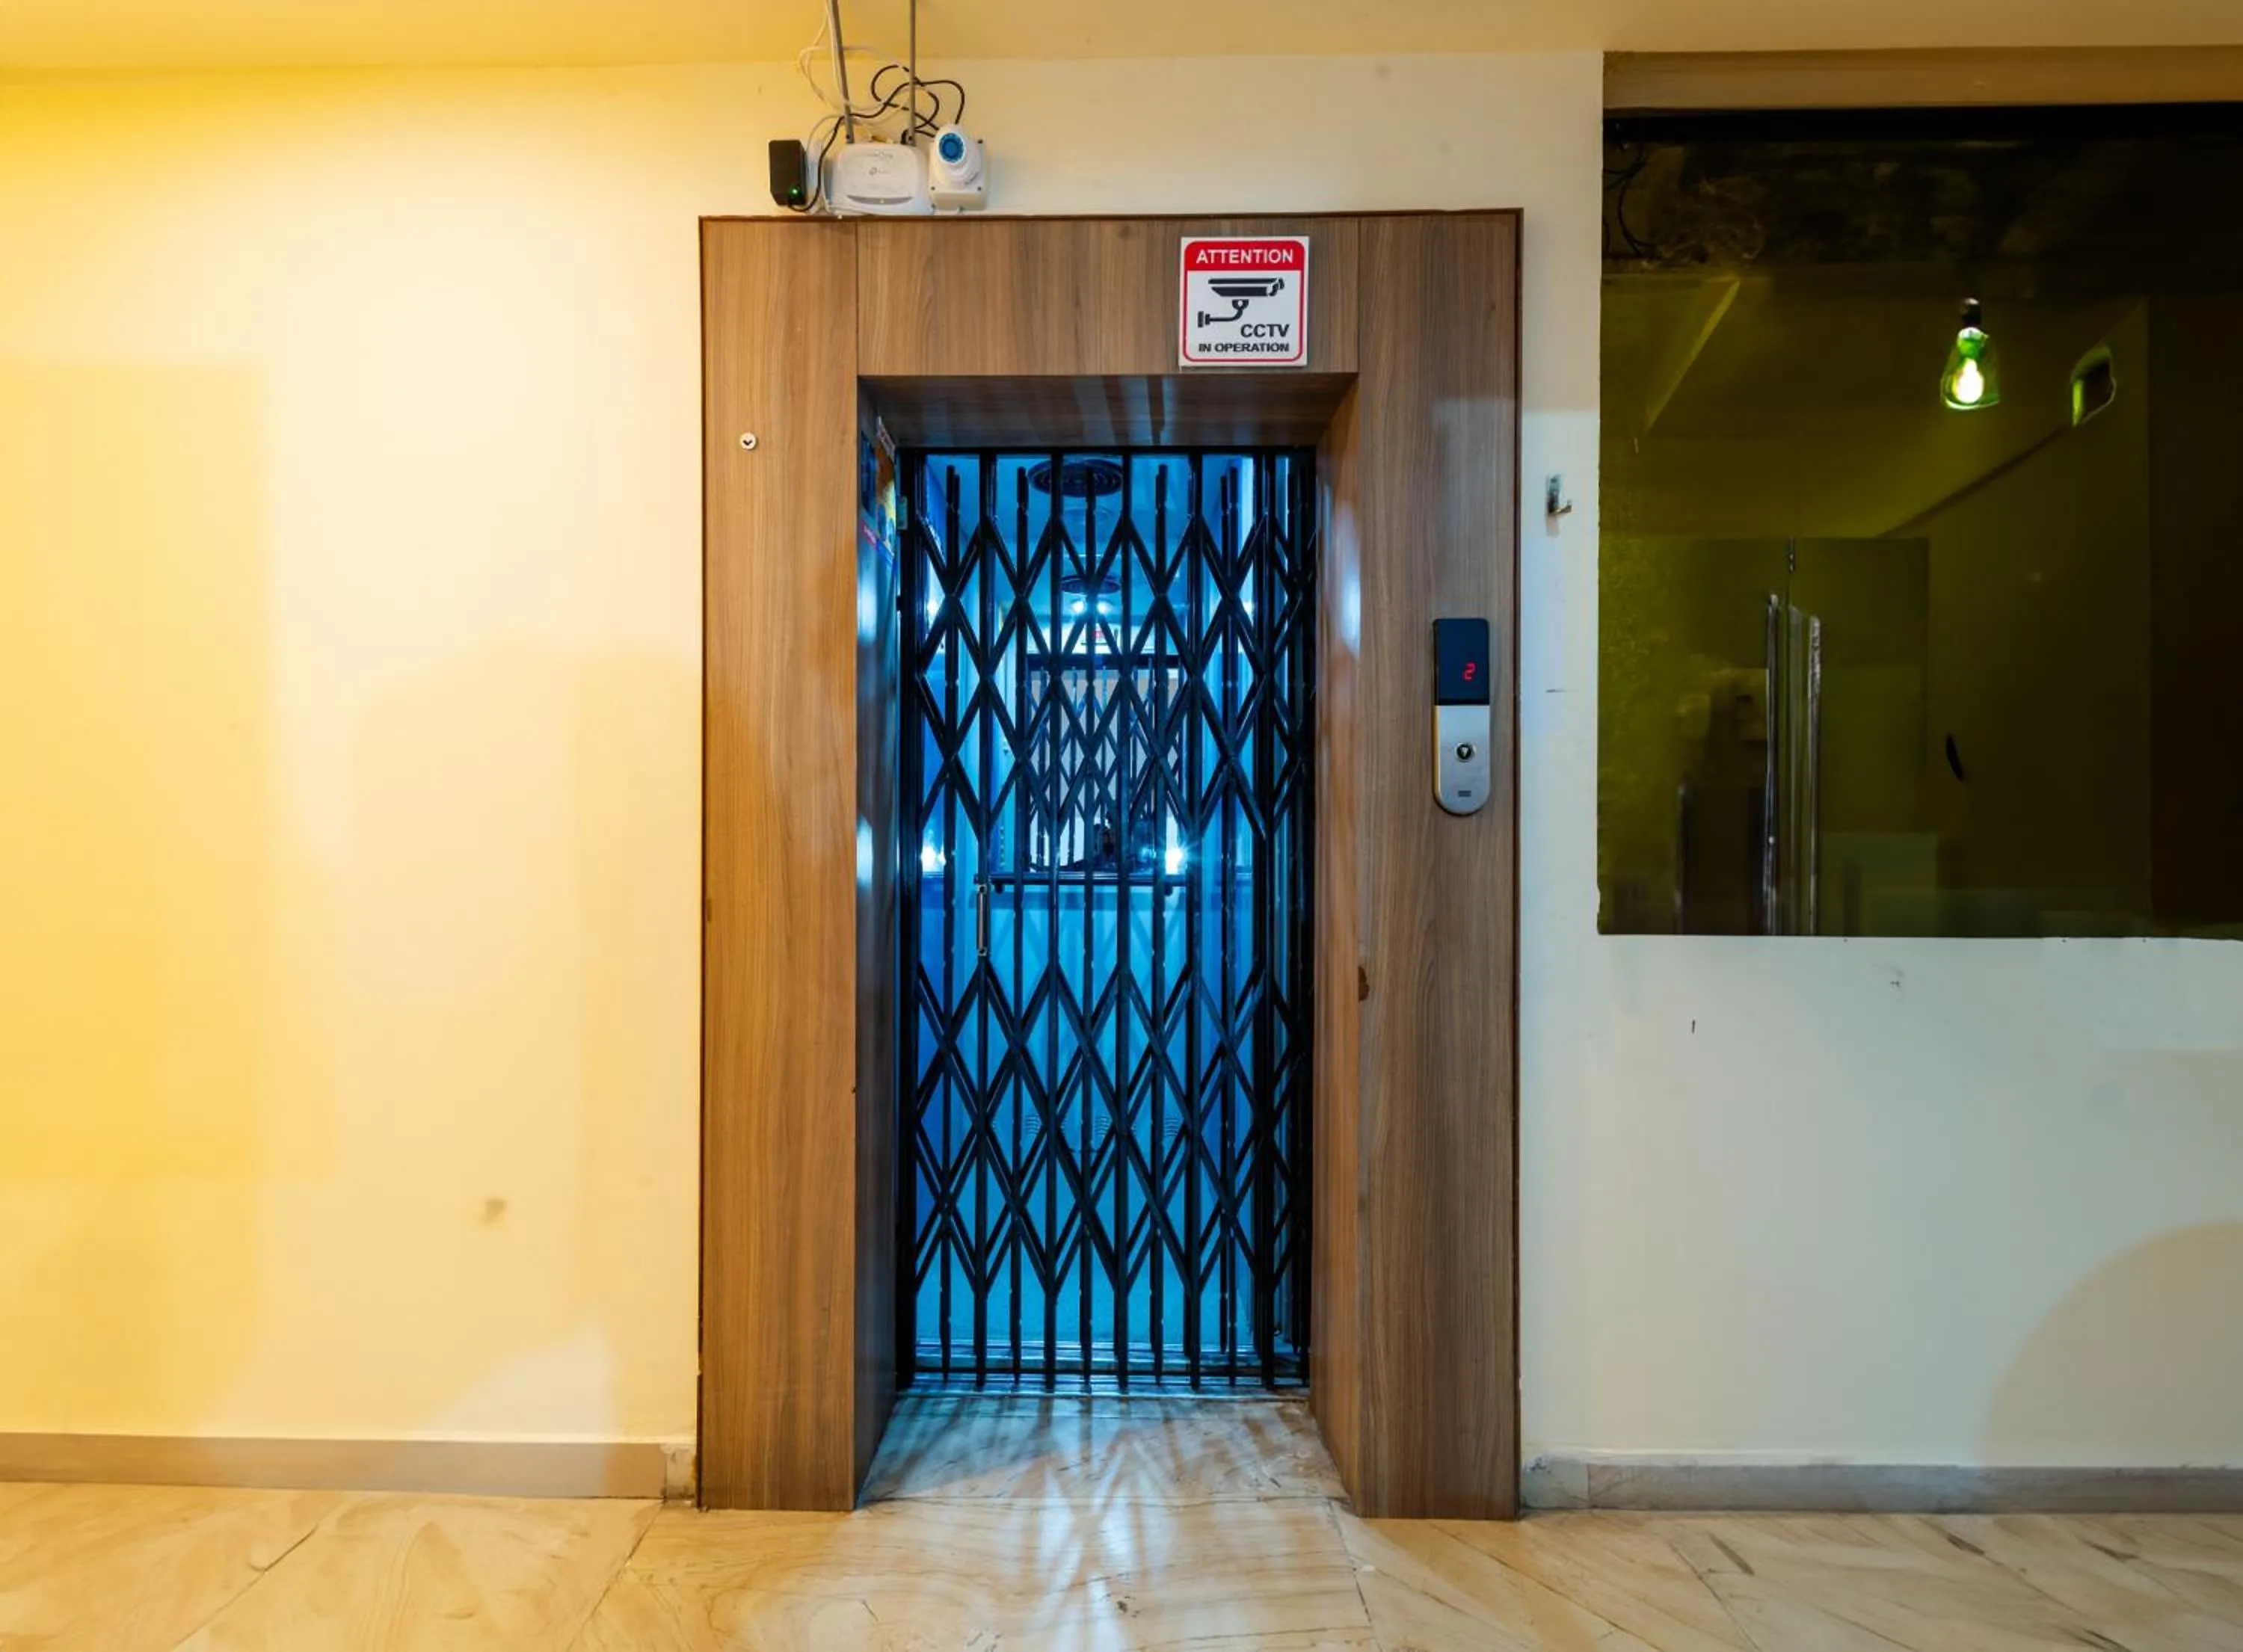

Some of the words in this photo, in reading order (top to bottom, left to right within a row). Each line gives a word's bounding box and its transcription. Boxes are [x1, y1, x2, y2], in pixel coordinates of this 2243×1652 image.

[1196, 249, 1293, 264] ATTENTION
[1240, 324, 1290, 338] CCTV
[1199, 343, 1211, 352] IN
[1214, 343, 1290, 352] OPERATION
[1462, 662, 1477, 681] 2
